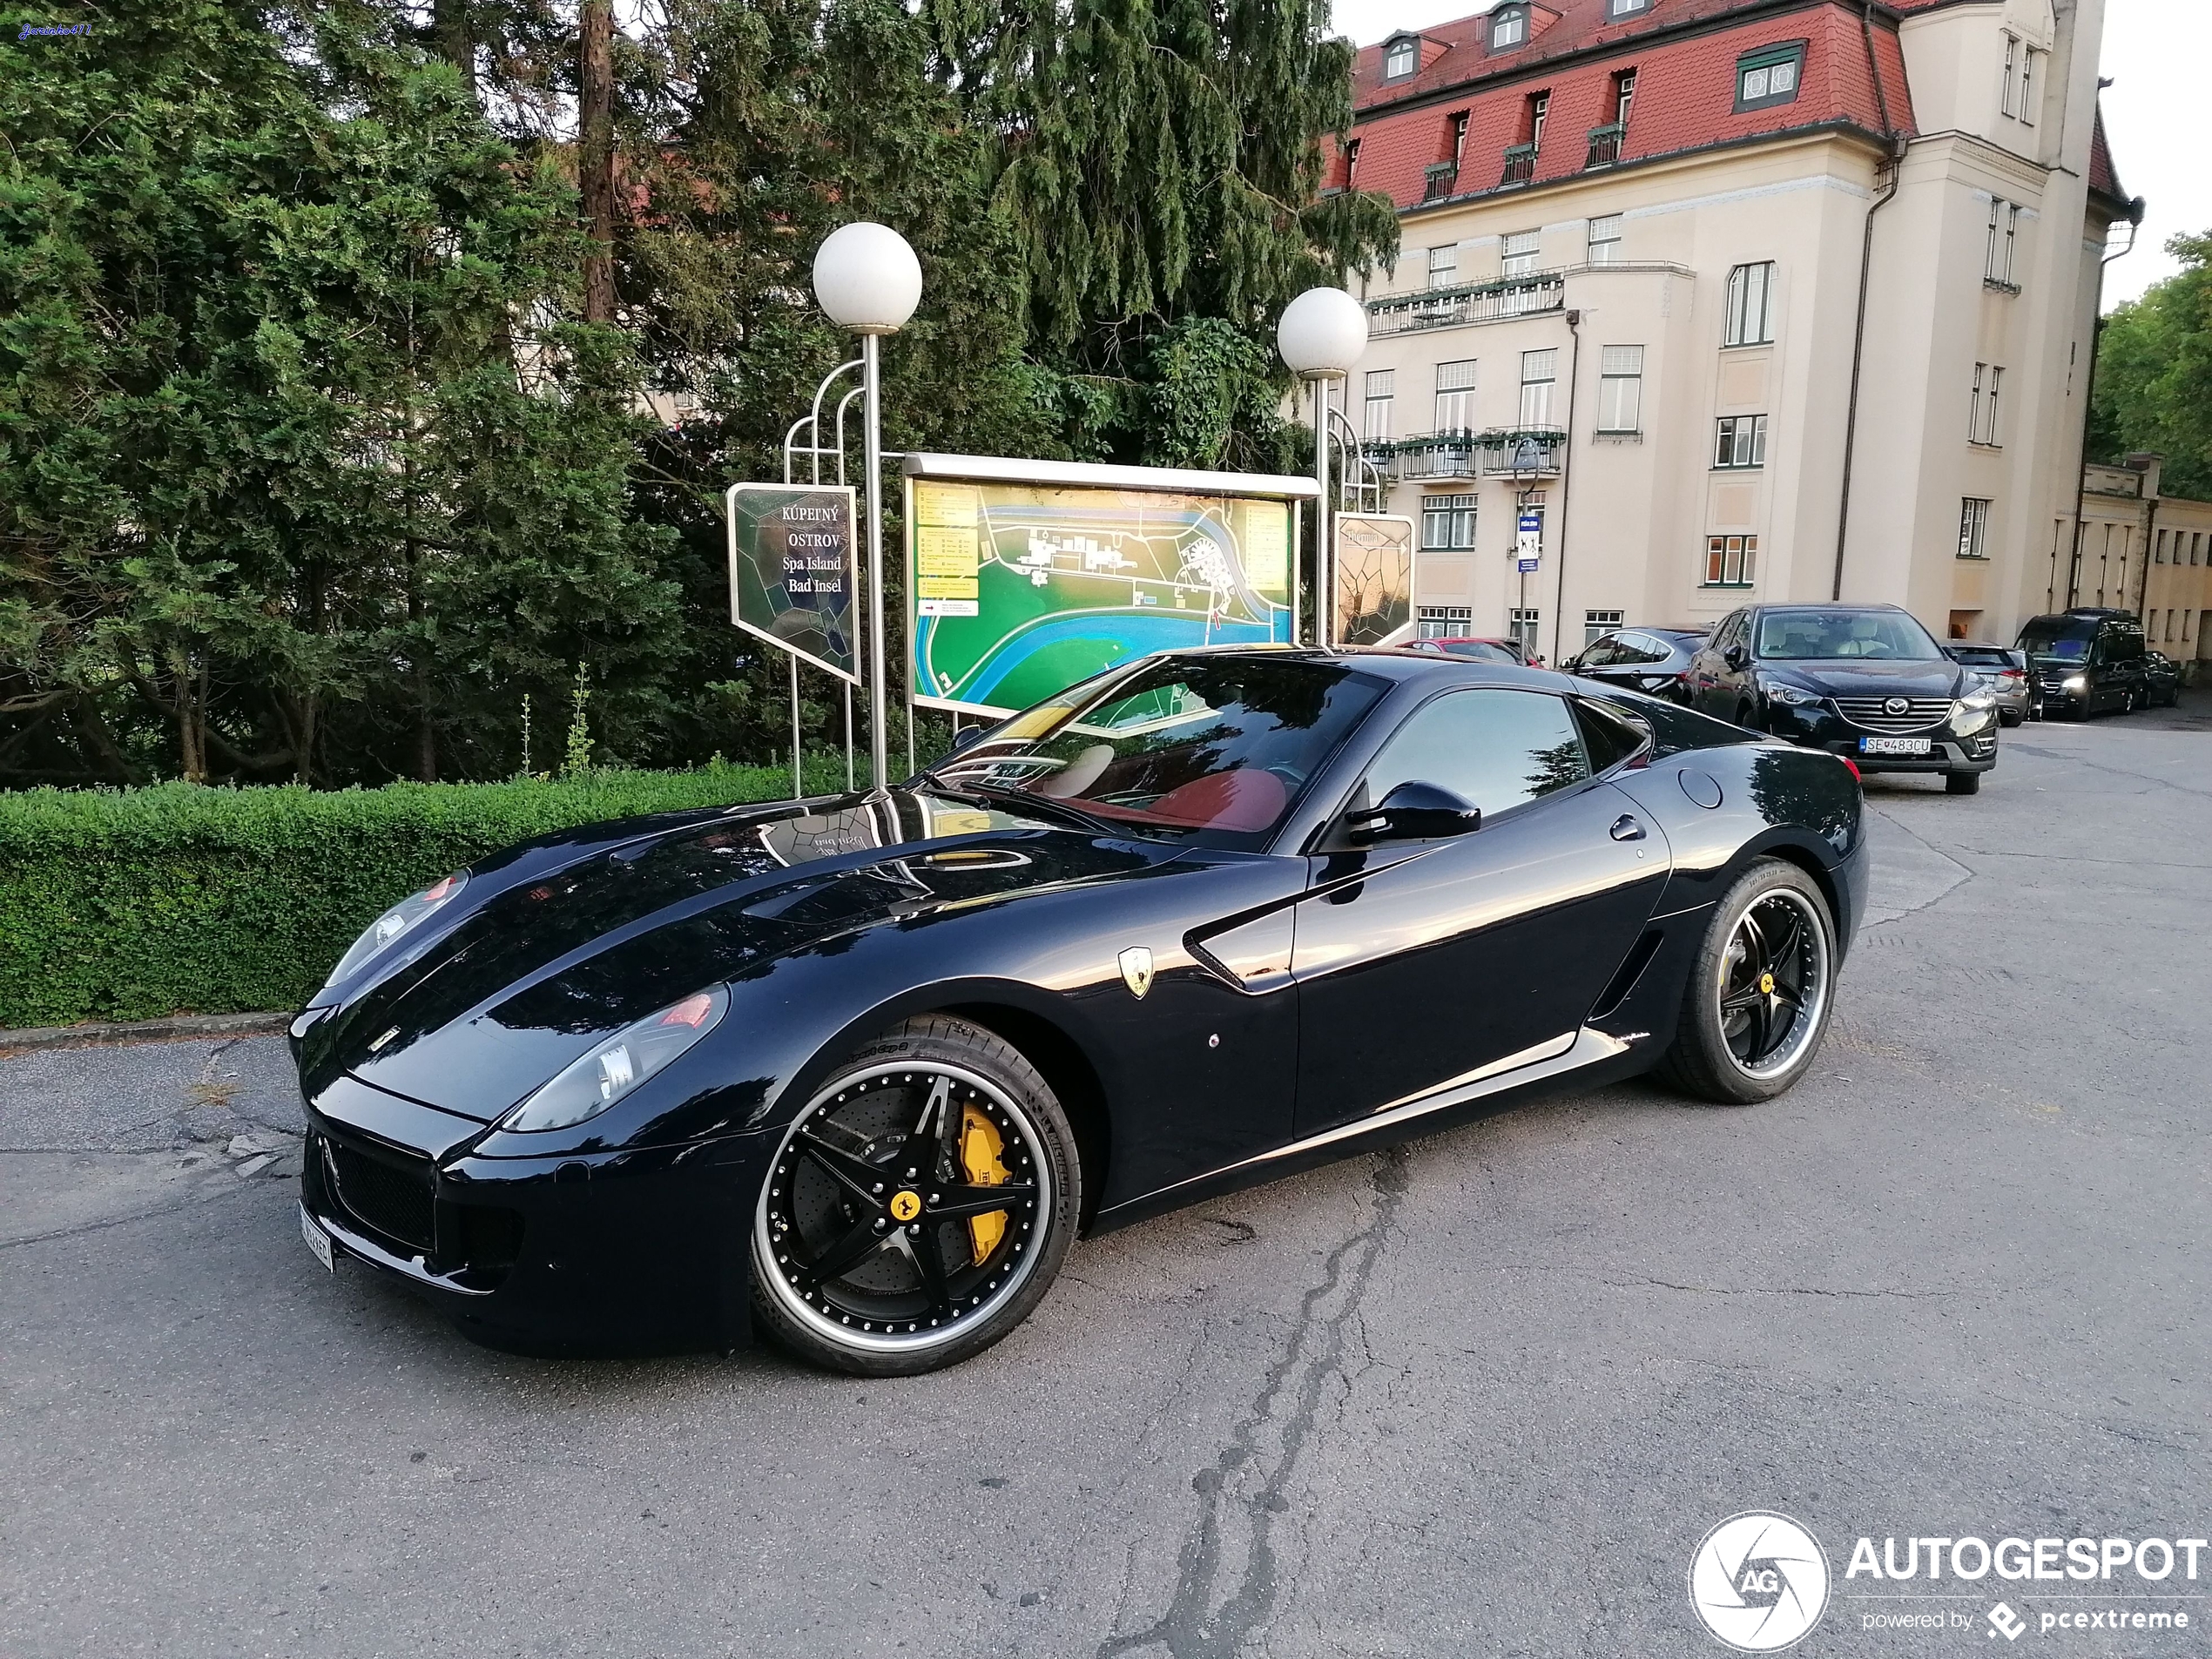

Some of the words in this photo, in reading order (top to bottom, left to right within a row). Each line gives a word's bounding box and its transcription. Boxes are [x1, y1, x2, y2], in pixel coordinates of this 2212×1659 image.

[788, 533, 840, 547] OSTROV
[1345, 529, 1378, 543] Thermia
[782, 556, 805, 574] Spa
[806, 556, 842, 570] Island
[788, 577, 812, 593] Bad
[814, 578, 842, 593] Insel
[877, 1042, 898, 1055] Cup
[898, 1042, 909, 1051] 2
[1047, 1131, 1069, 1199] MICHELIN
